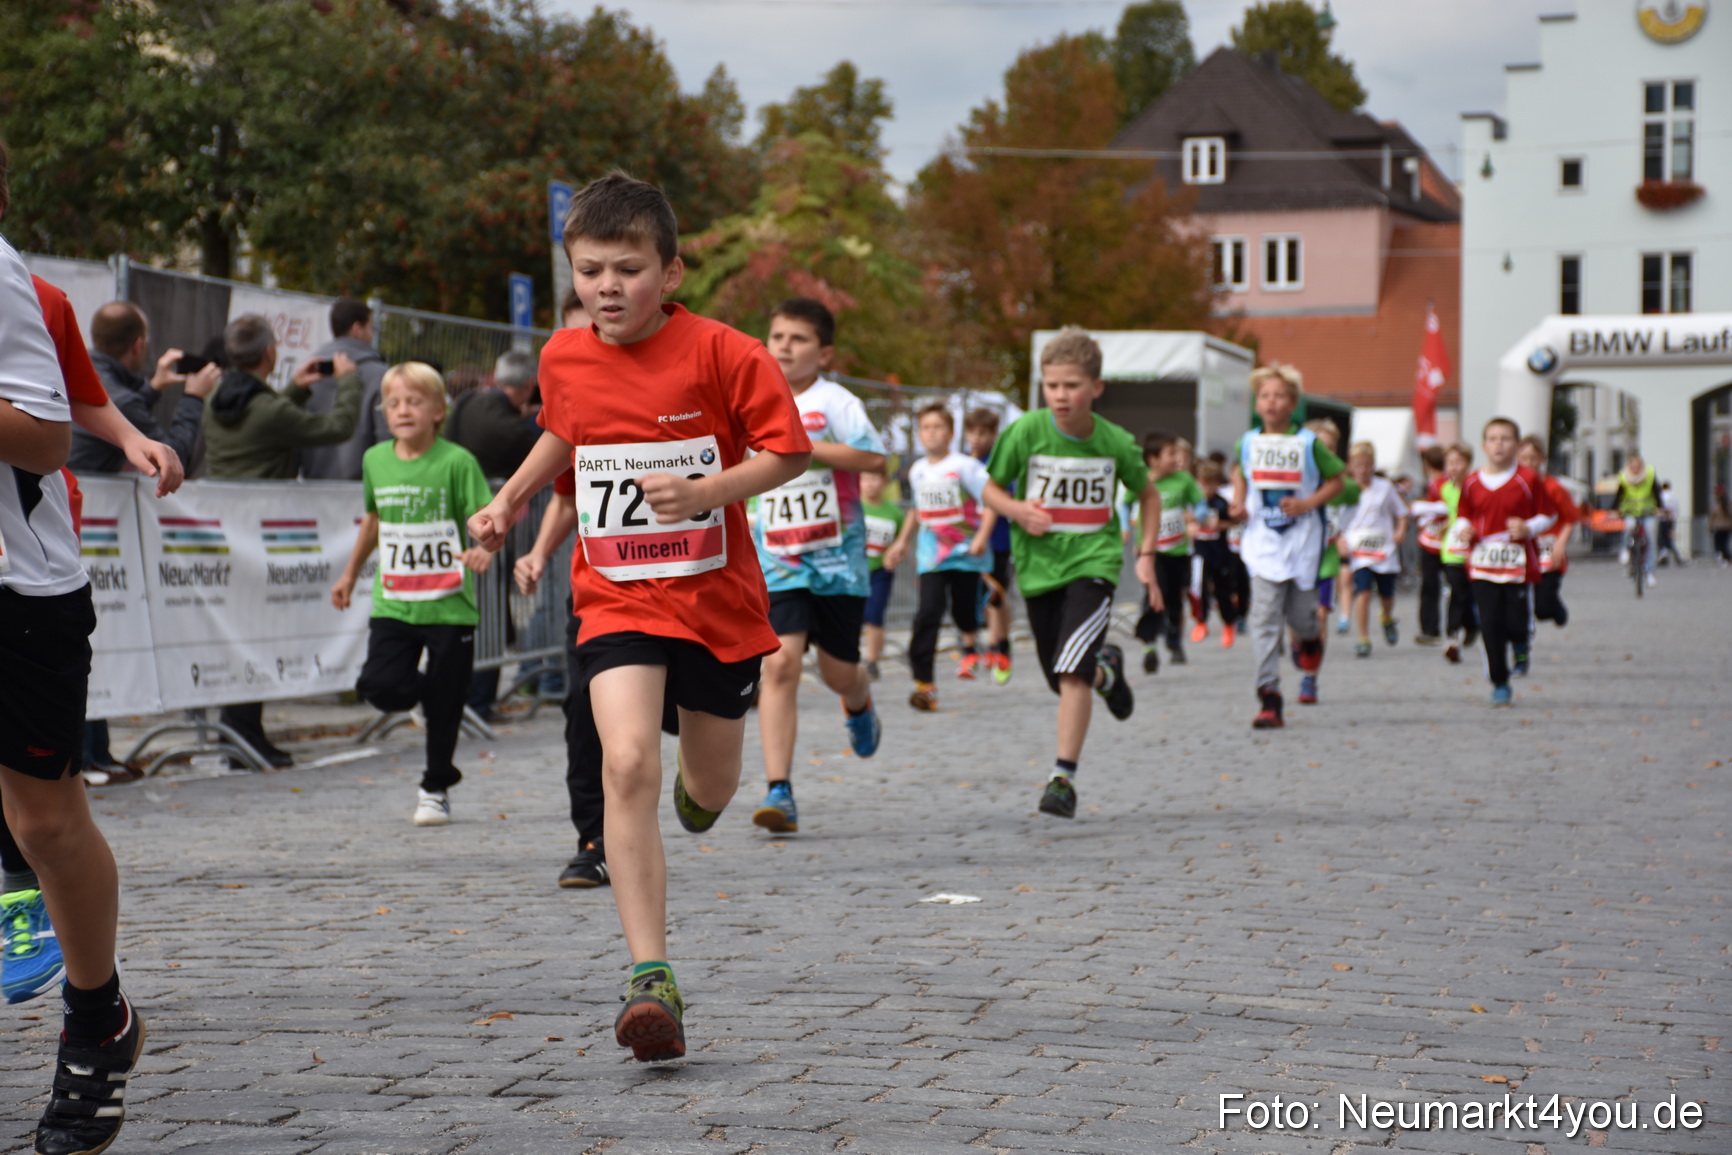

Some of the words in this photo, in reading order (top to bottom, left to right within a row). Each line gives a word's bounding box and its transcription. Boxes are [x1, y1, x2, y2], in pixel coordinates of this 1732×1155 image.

[1569, 330, 1654, 354] BMW
[658, 415, 668, 423] FC
[669, 410, 702, 422] Holzheim
[579, 458, 622, 472] PARTL
[625, 455, 695, 471] Neumarkt
[1256, 448, 1299, 468] 7059
[1037, 475, 1105, 504] 7405
[765, 490, 830, 525] 7412
[386, 540, 453, 571] 7446
[616, 538, 690, 561] Vincent
[1478, 546, 1520, 564] 7002
